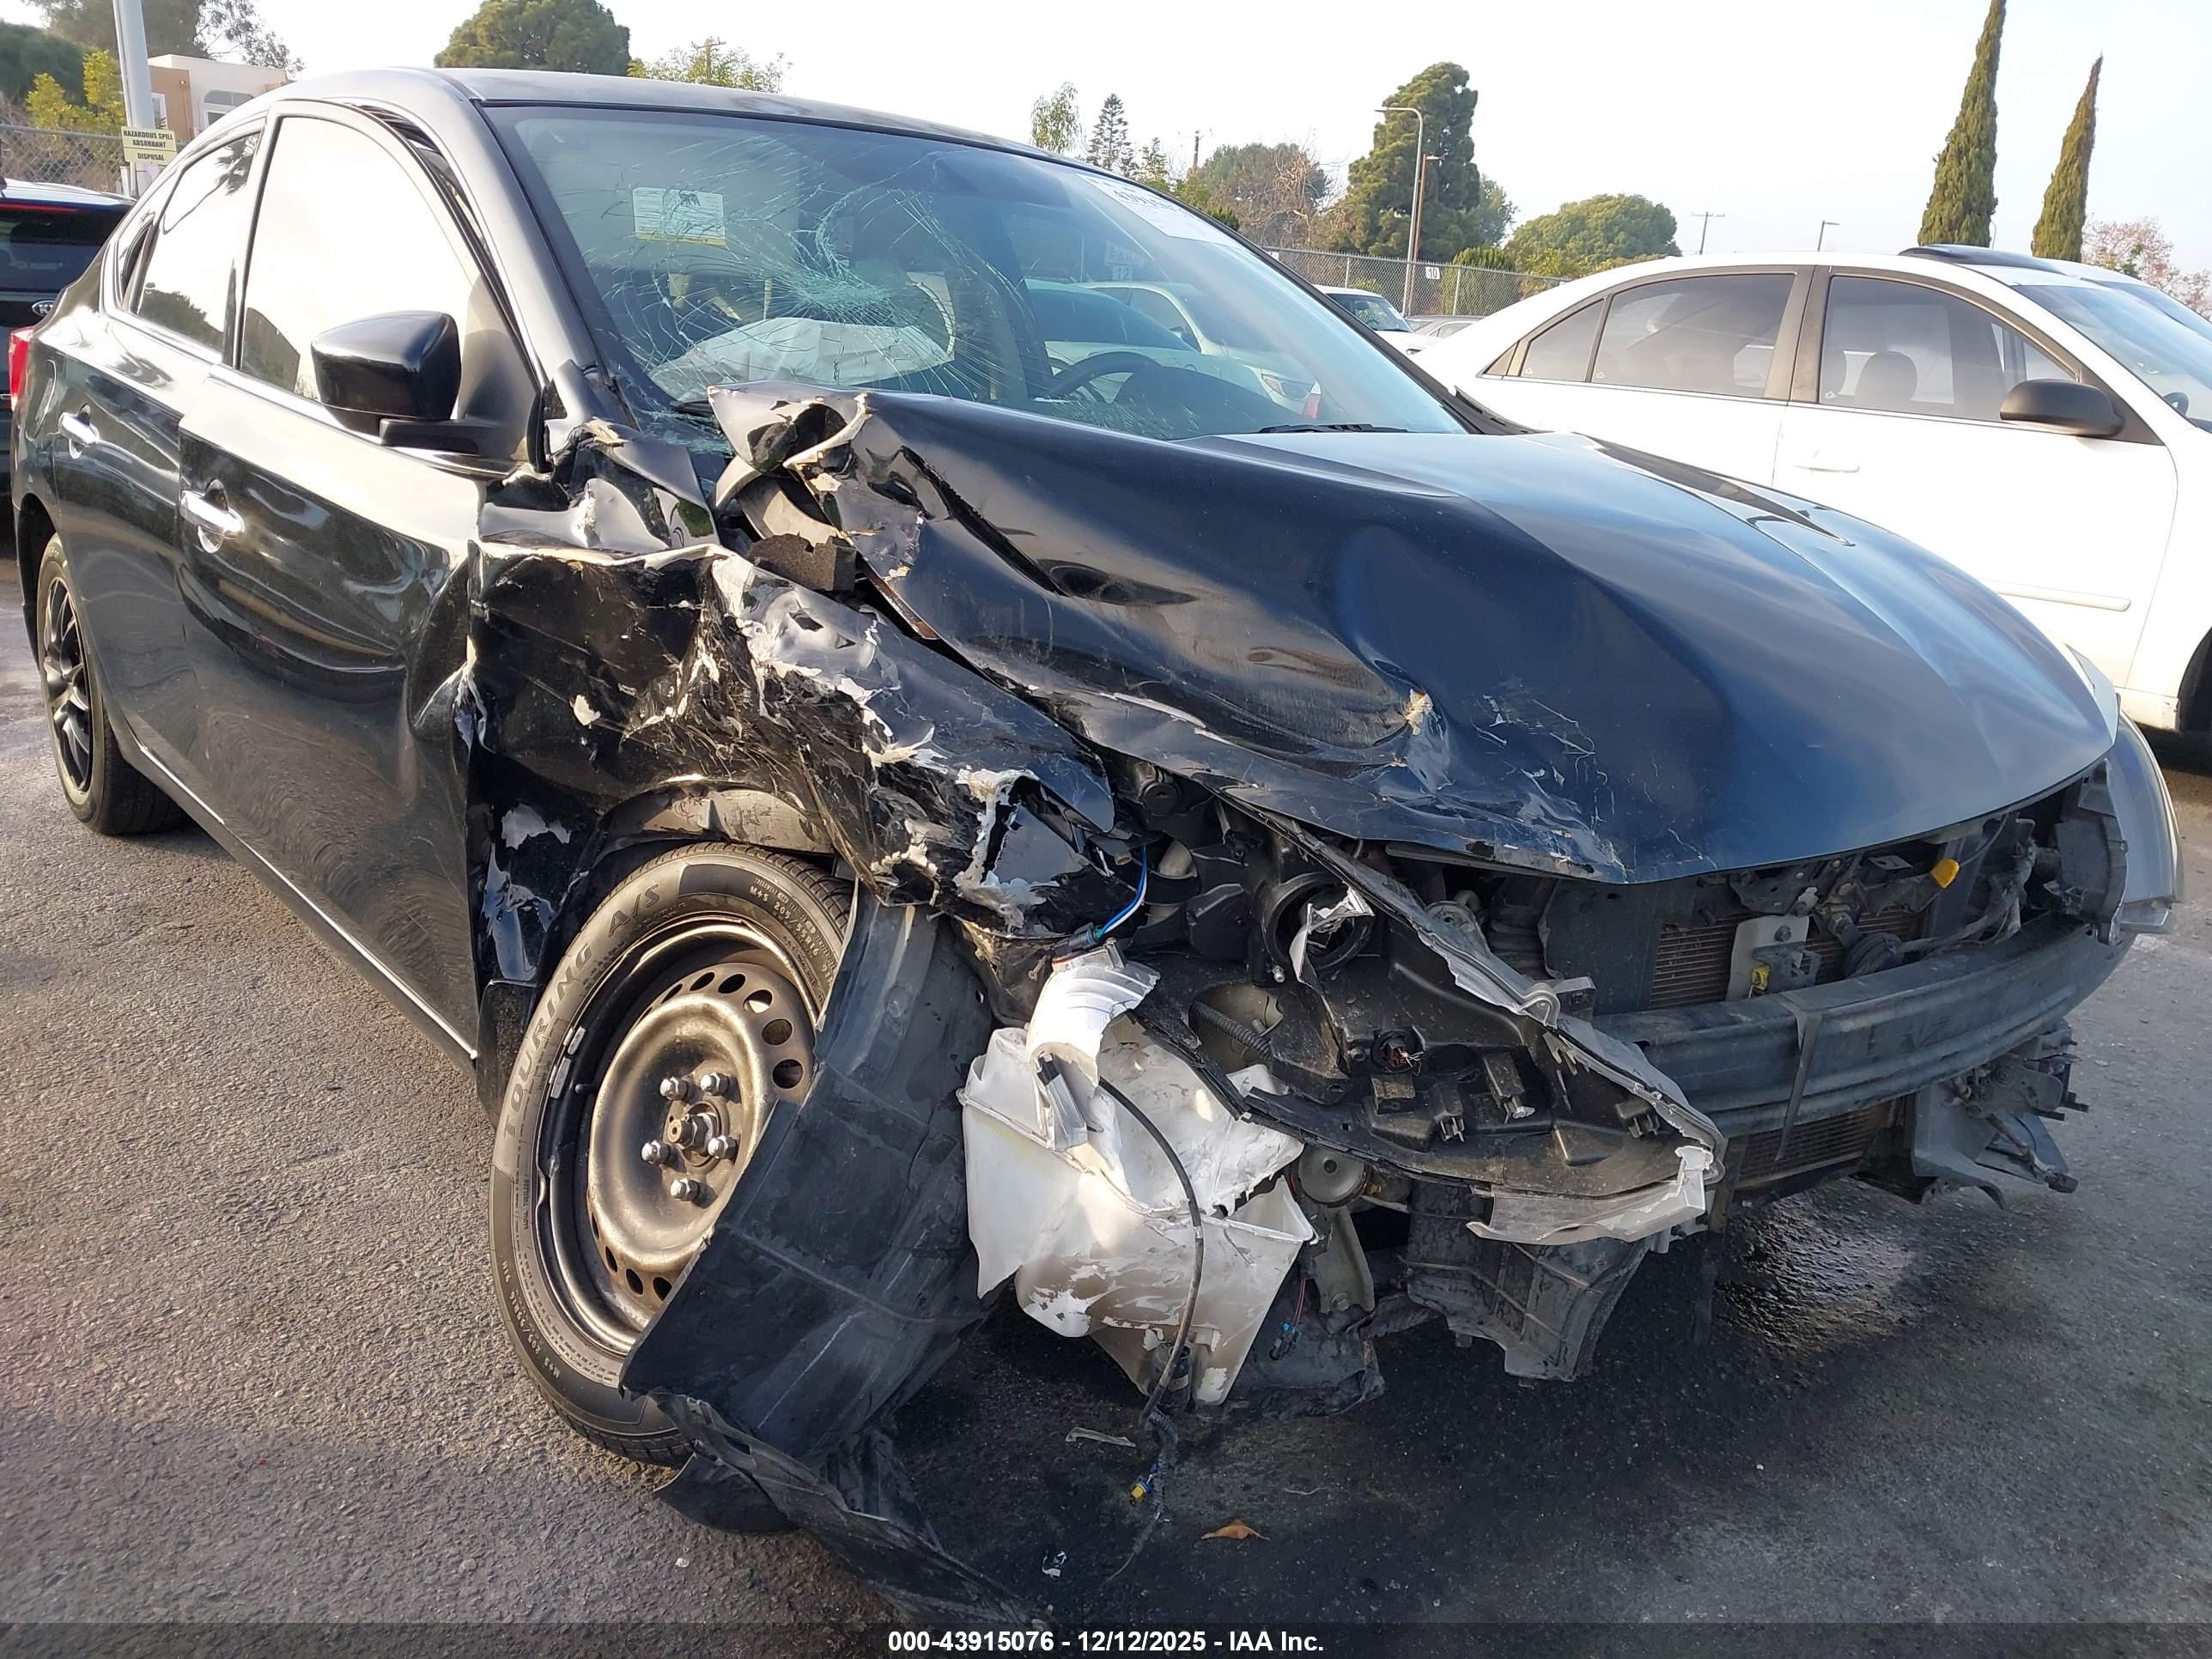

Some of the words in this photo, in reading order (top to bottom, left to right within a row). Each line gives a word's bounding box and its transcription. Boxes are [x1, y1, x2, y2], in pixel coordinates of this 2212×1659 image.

[123, 130, 157, 139] HAZARDOUS
[1428, 268, 1437, 278] 10
[39, 304, 54, 314] KI
[749, 885, 769, 902] M+S
[774, 902, 821, 957] 205/55R16
[504, 944, 592, 1140] TOURING
[609, 883, 660, 938] A/S
